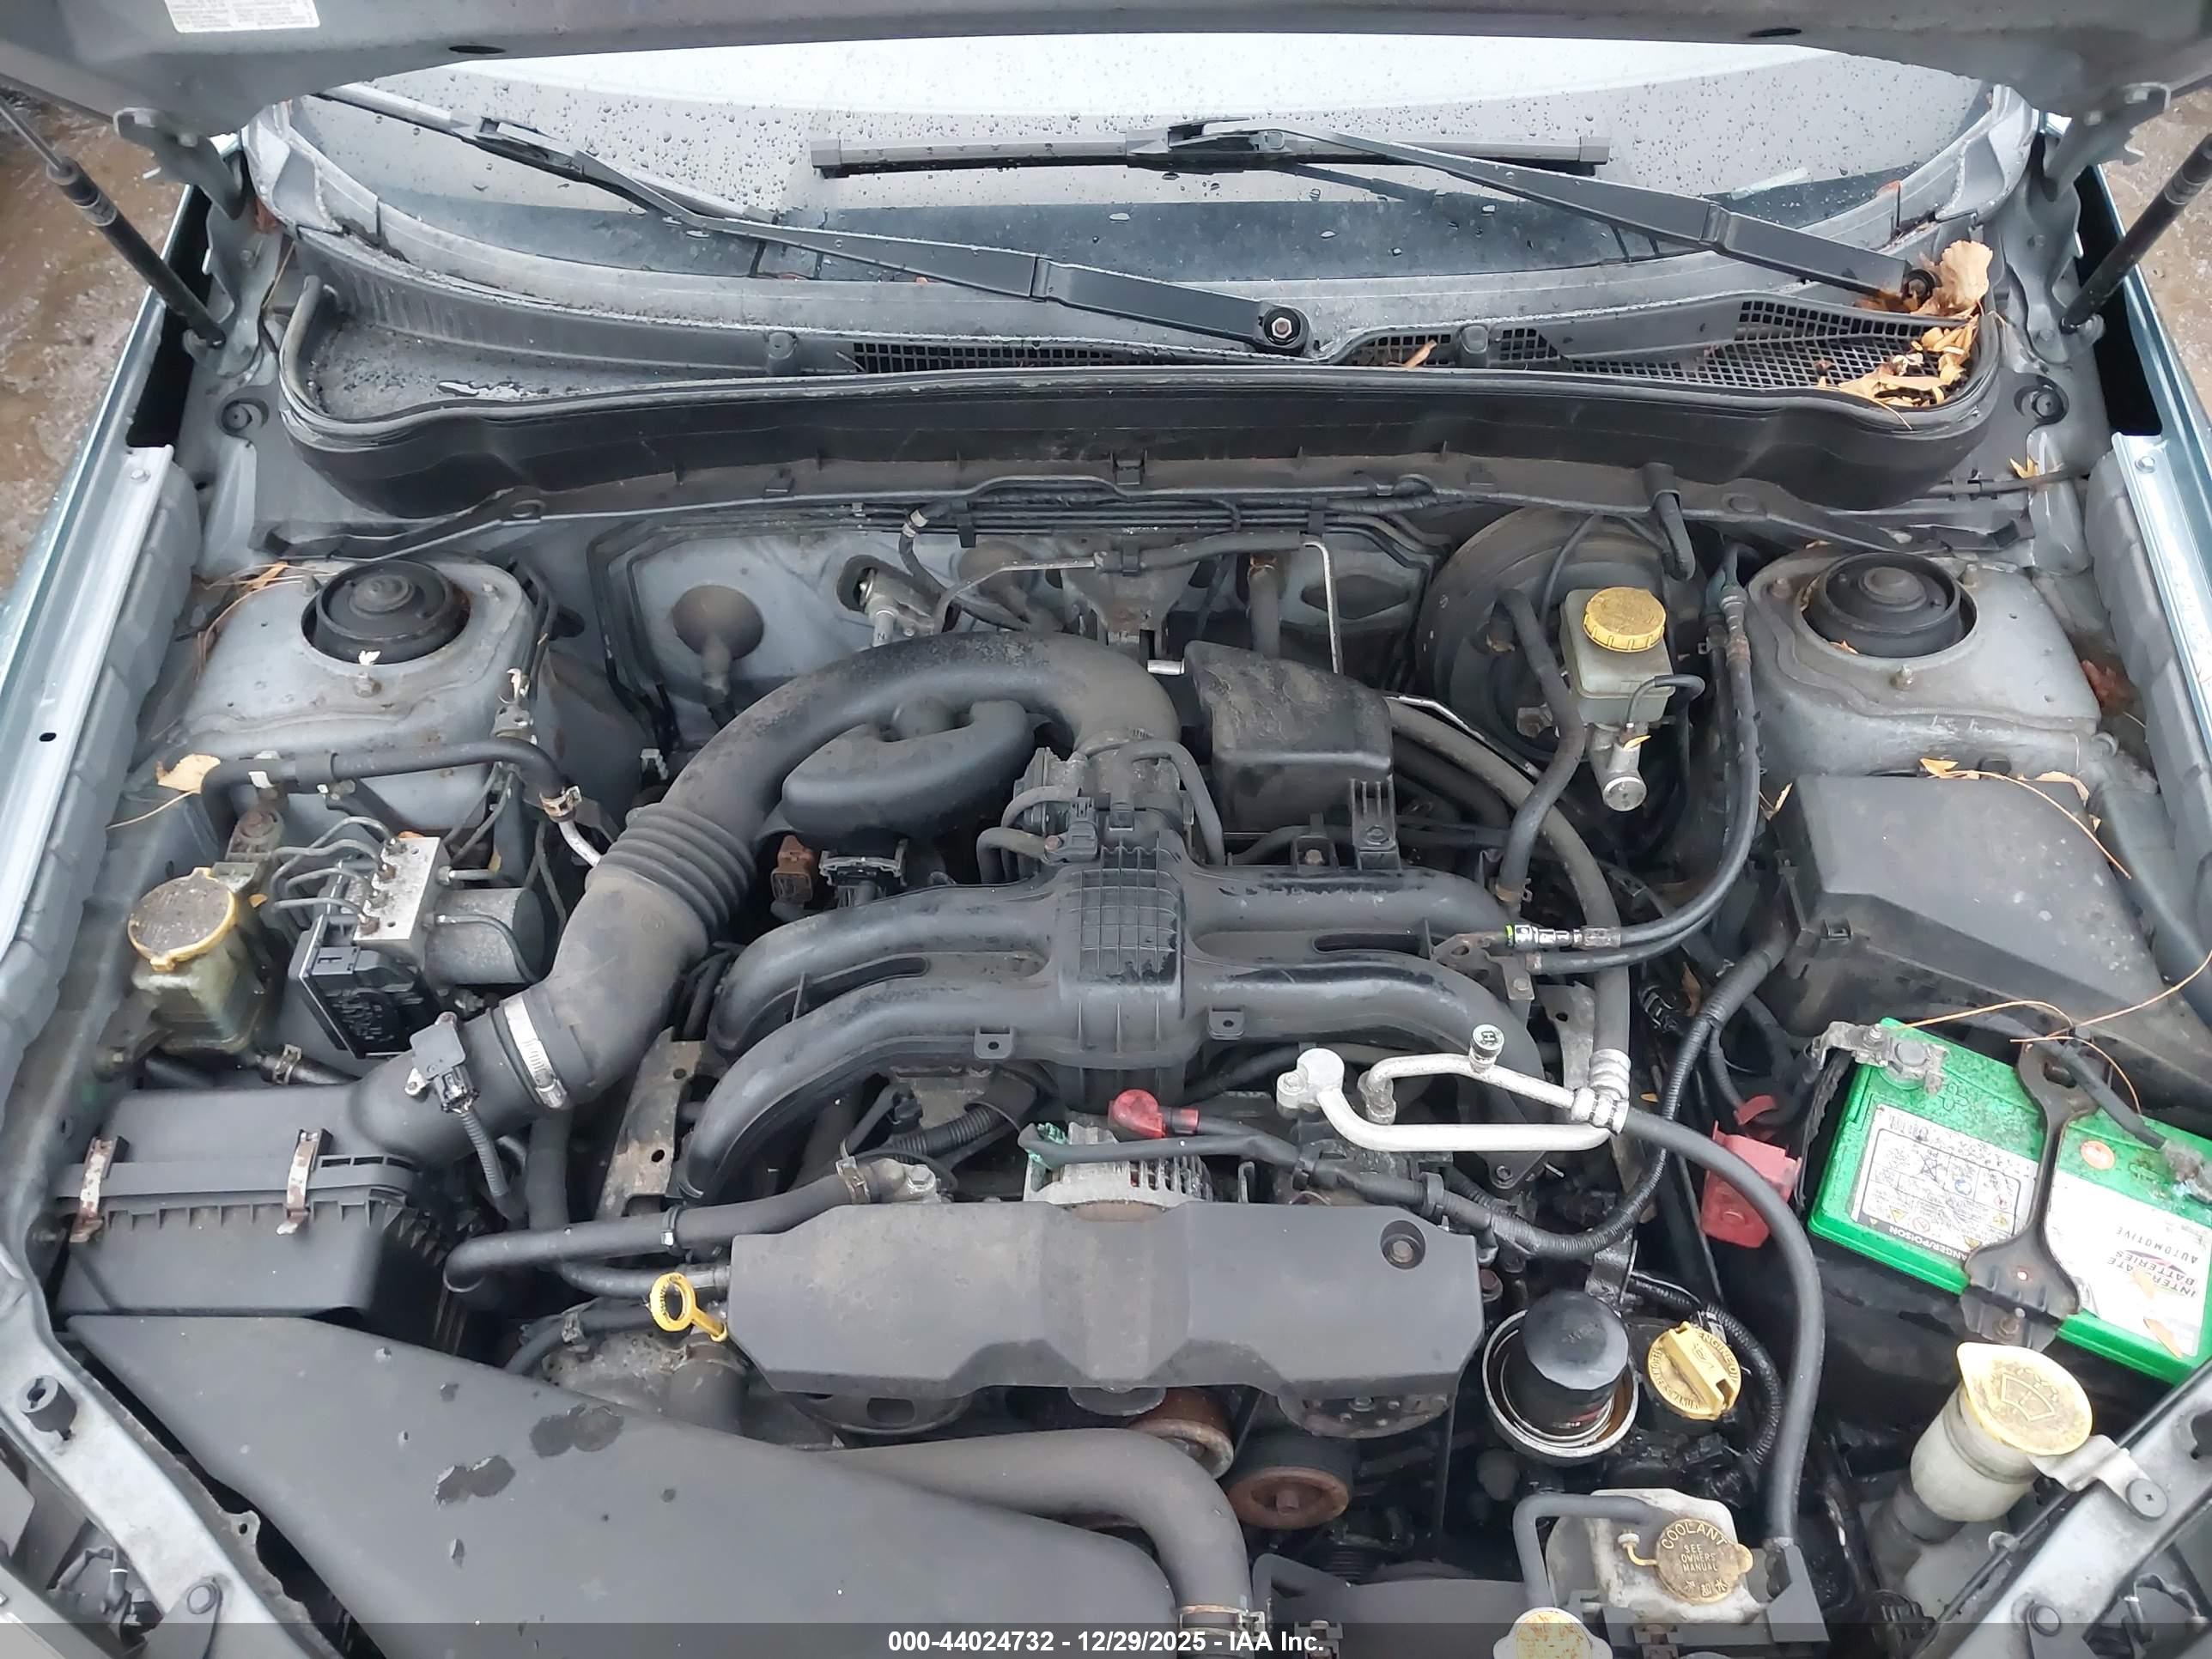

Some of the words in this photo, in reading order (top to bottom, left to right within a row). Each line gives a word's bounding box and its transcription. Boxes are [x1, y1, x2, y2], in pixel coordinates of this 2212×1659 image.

[1889, 1225, 1967, 1261] ANGER/POISON
[2116, 1226, 2199, 1264] AUTOMOTIVE
[2107, 1257, 2196, 1297] INTERATE
[2115, 1250, 2195, 1286] BATTERIES
[1662, 1522, 1728, 1549] COOLANT
[1684, 1544, 1702, 1553] SEE
[1680, 1553, 1716, 1563] OWNERS
[1682, 1562, 1718, 1572] MANUAL
